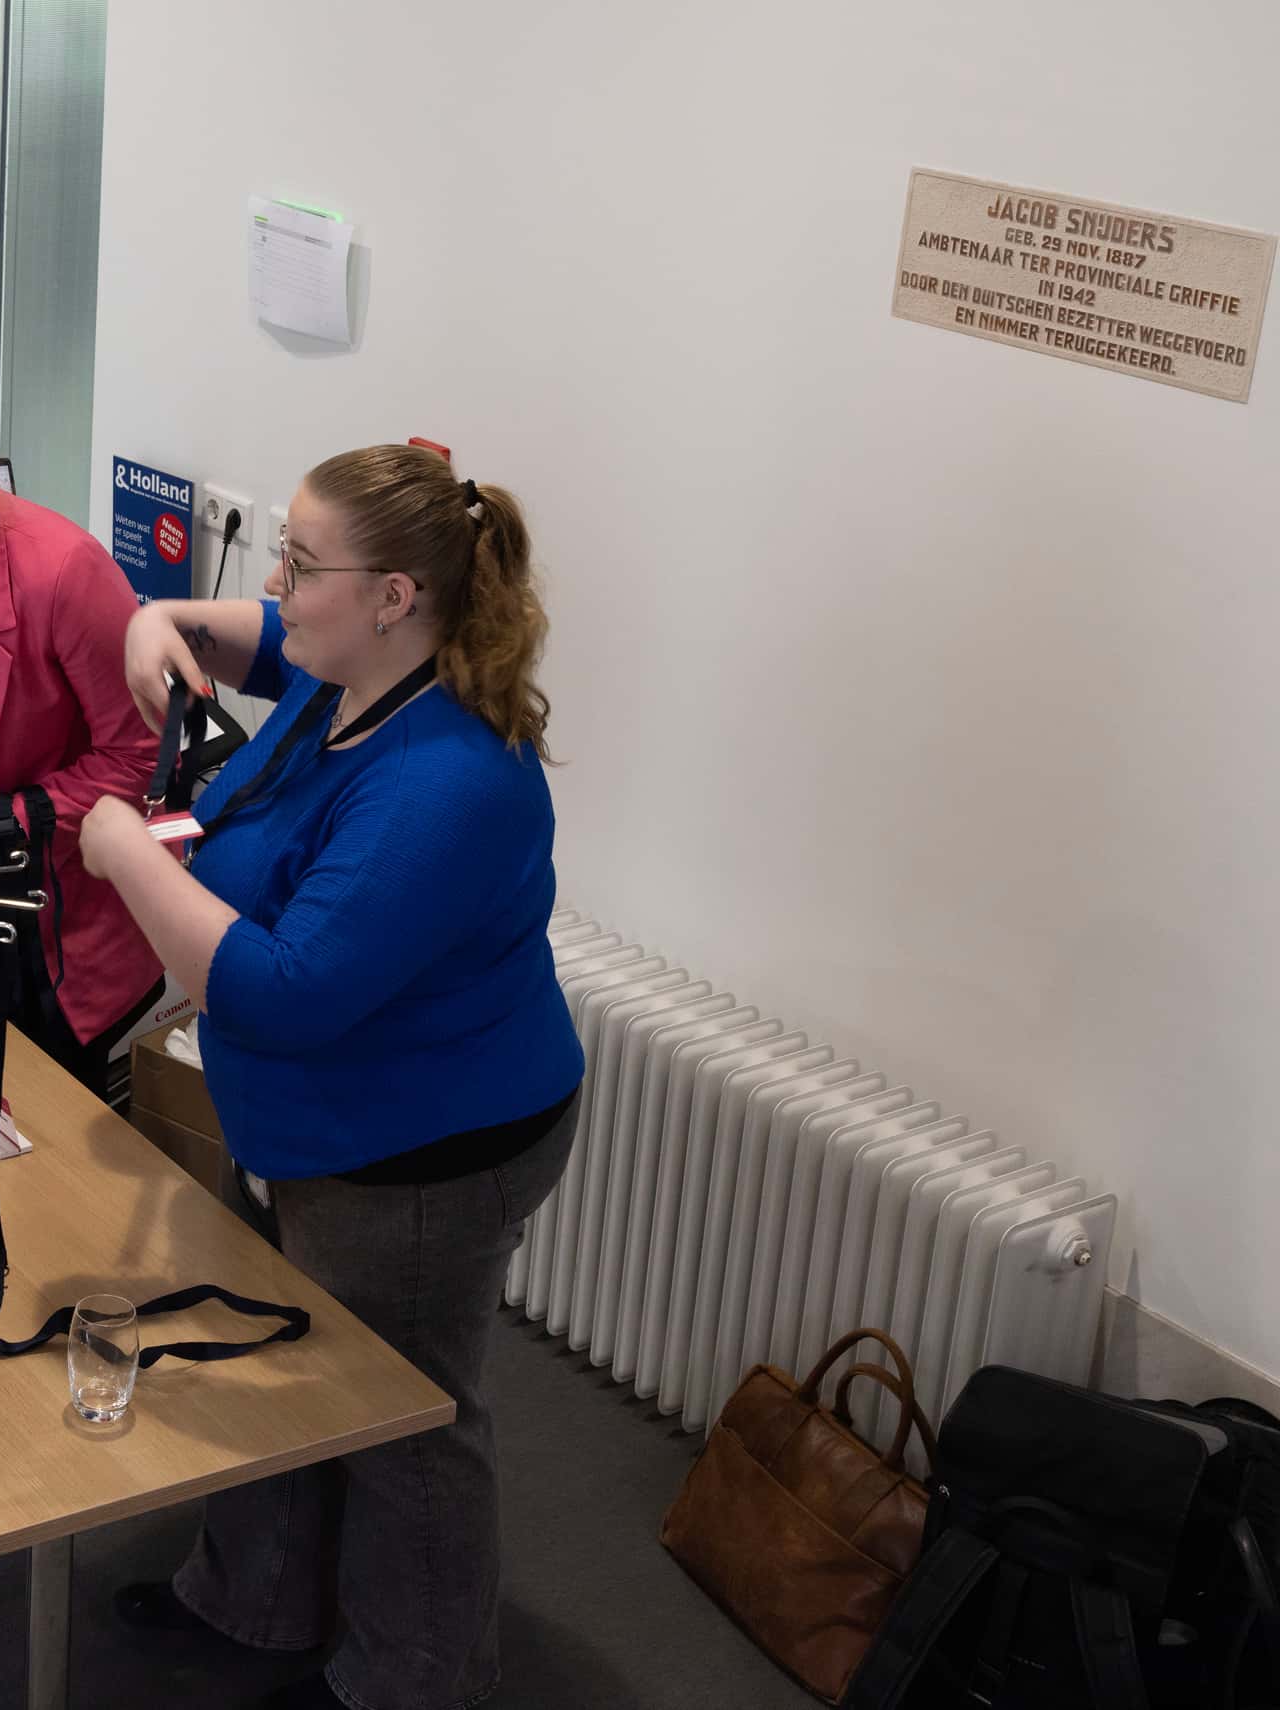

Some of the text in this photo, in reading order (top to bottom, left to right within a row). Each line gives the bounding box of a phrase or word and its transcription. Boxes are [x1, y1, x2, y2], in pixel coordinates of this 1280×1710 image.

[987, 193, 1058, 229] JACOB
[1005, 228, 1147, 269] GEB. 29 NOV. 1887
[919, 231, 1241, 315] AMBTENAAR TER PROVINCIALE GRIFFIE
[1038, 280, 1097, 307] IN 1942
[901, 270, 1247, 367] DOOR DEN DUITSCHEN BEZETTER WEGGEVOERD
[955, 306, 1176, 375] EN NIMMER TERUGGEKEERD.
[115, 464, 129, 490] &
[130, 467, 189, 504] Holland
[115, 513, 150, 534] Weten wat
[115, 527, 122, 535] er
[162, 517, 184, 540] Neem
[115, 537, 147, 557] binnen de
[160, 529, 182, 550] gratis
[160, 539, 179, 558] mee!
[155, 998, 191, 1022] Canon
